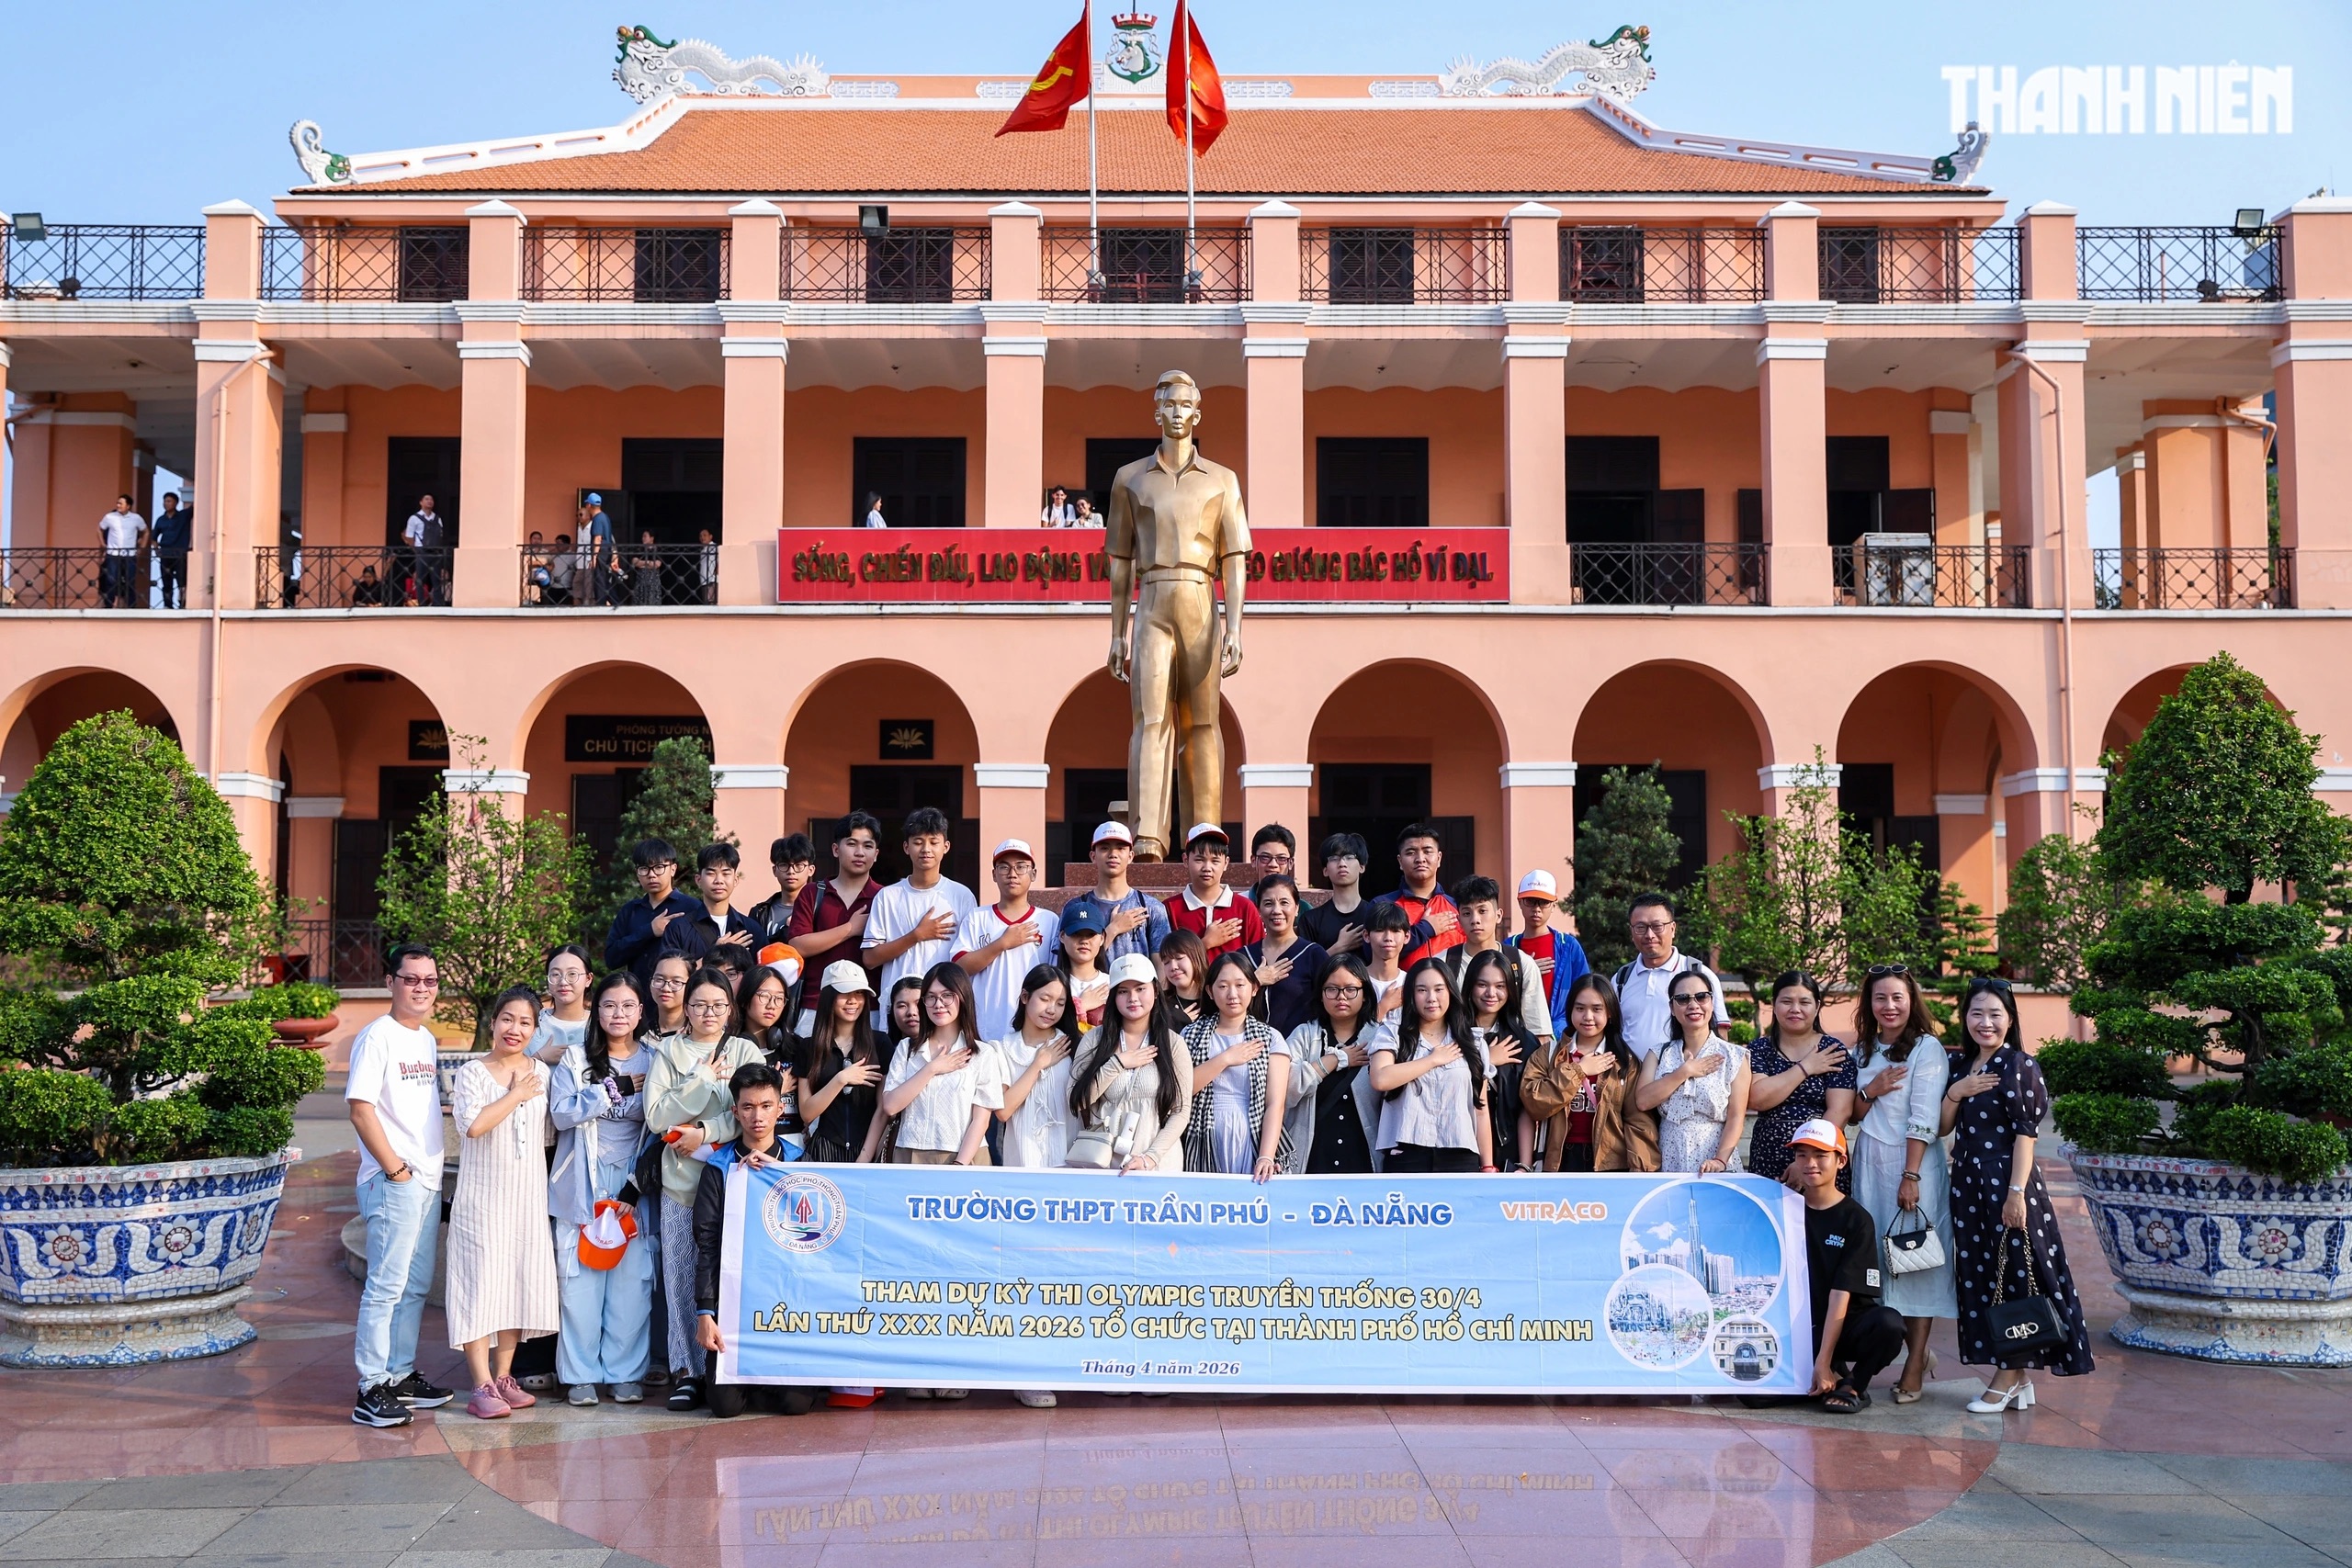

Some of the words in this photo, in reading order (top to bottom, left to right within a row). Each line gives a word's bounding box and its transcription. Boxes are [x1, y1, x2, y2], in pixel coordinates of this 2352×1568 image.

[794, 540, 855, 588] SỐNG,
[863, 542, 922, 581] CHIẾN
[930, 543, 974, 588] ĐẤU,
[979, 552, 1018, 581] LAO
[1024, 546, 1081, 589] ĐỘNG
[1272, 546, 1341, 581] GƯƠNG
[1349, 545, 1387, 581] BÁC
[1393, 540, 1422, 581] HỒ
[584, 736, 617, 753] CHỦ
[908, 1192, 1036, 1222] TRƯỜNG
[1045, 1199, 1116, 1222] THPT
[1123, 1192, 1203, 1224] TRẦN
[1210, 1197, 1270, 1224] PHÚ
[1310, 1197, 1352, 1224] ĐÀ
[1364, 1193, 1453, 1225] NẴNG
[1500, 1199, 1608, 1223] VITRACO
[861, 1280, 942, 1303] THAM
[947, 1281, 990, 1309] DỰ
[994, 1278, 1034, 1304] KỲ
[1039, 1284, 1081, 1305] THI
[1087, 1284, 1204, 1307] OLYMPIC
[1210, 1278, 1313, 1308] TRUYỀN
[1318, 1279, 1416, 1309] THỐNG
[1420, 1287, 1482, 1311] 30/4
[753, 1302, 810, 1333] LẦN
[816, 1307, 875, 1335] THỨ
[879, 1314, 942, 1336] XXX
[947, 1308, 1013, 1337] NĂM
[1020, 1315, 1084, 1337] 2026
[1090, 1306, 1126, 1338] TỔ
[1131, 1312, 1206, 1339] CHỨC
[1212, 1317, 1255, 1345] TẠI
[1261, 1313, 1356, 1340] THÀNH
[1361, 1311, 1419, 1341] PHỐ
[1424, 1311, 1464, 1341] HỒ
[1470, 1314, 1514, 1341] CHÍ
[1520, 1319, 1593, 1341] MINH
[1082, 1360, 1136, 1377] Tháng
[1140, 1361, 1151, 1374] 4
[1157, 1361, 1193, 1374] năm
[1198, 1362, 1240, 1375] 2026
